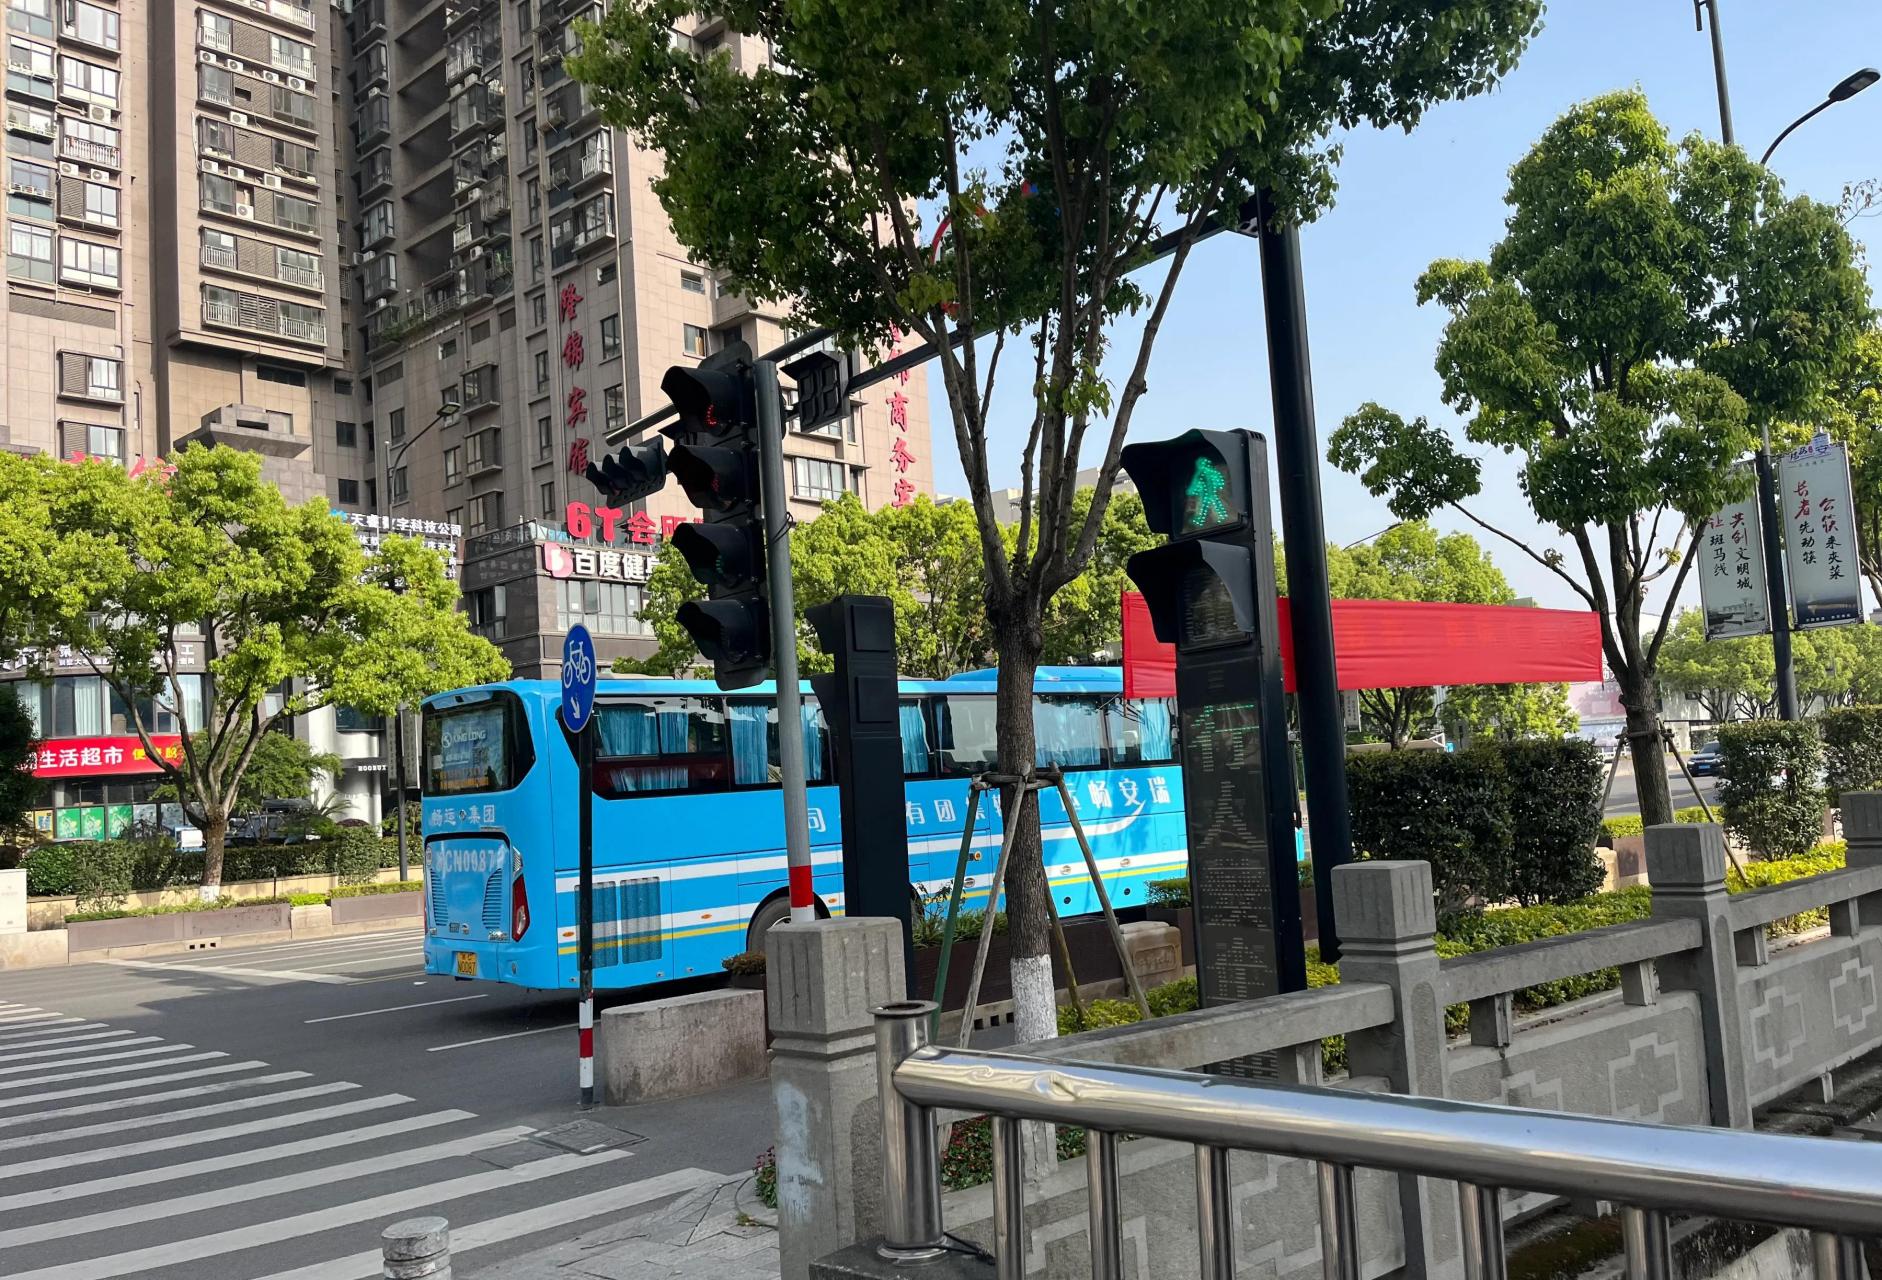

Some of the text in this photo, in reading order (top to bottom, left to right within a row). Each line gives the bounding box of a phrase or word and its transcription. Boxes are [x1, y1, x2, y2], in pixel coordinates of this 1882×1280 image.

[560, 283, 590, 475] 隆锦宾馆
[566, 500, 704, 546] 6T会所
[1730, 512, 1753, 589] 共创文明城
[1793, 480, 1817, 565] 长者先动筷
[1819, 497, 1845, 580] 公筷来夹菜
[468, 804, 496, 825] 集团
